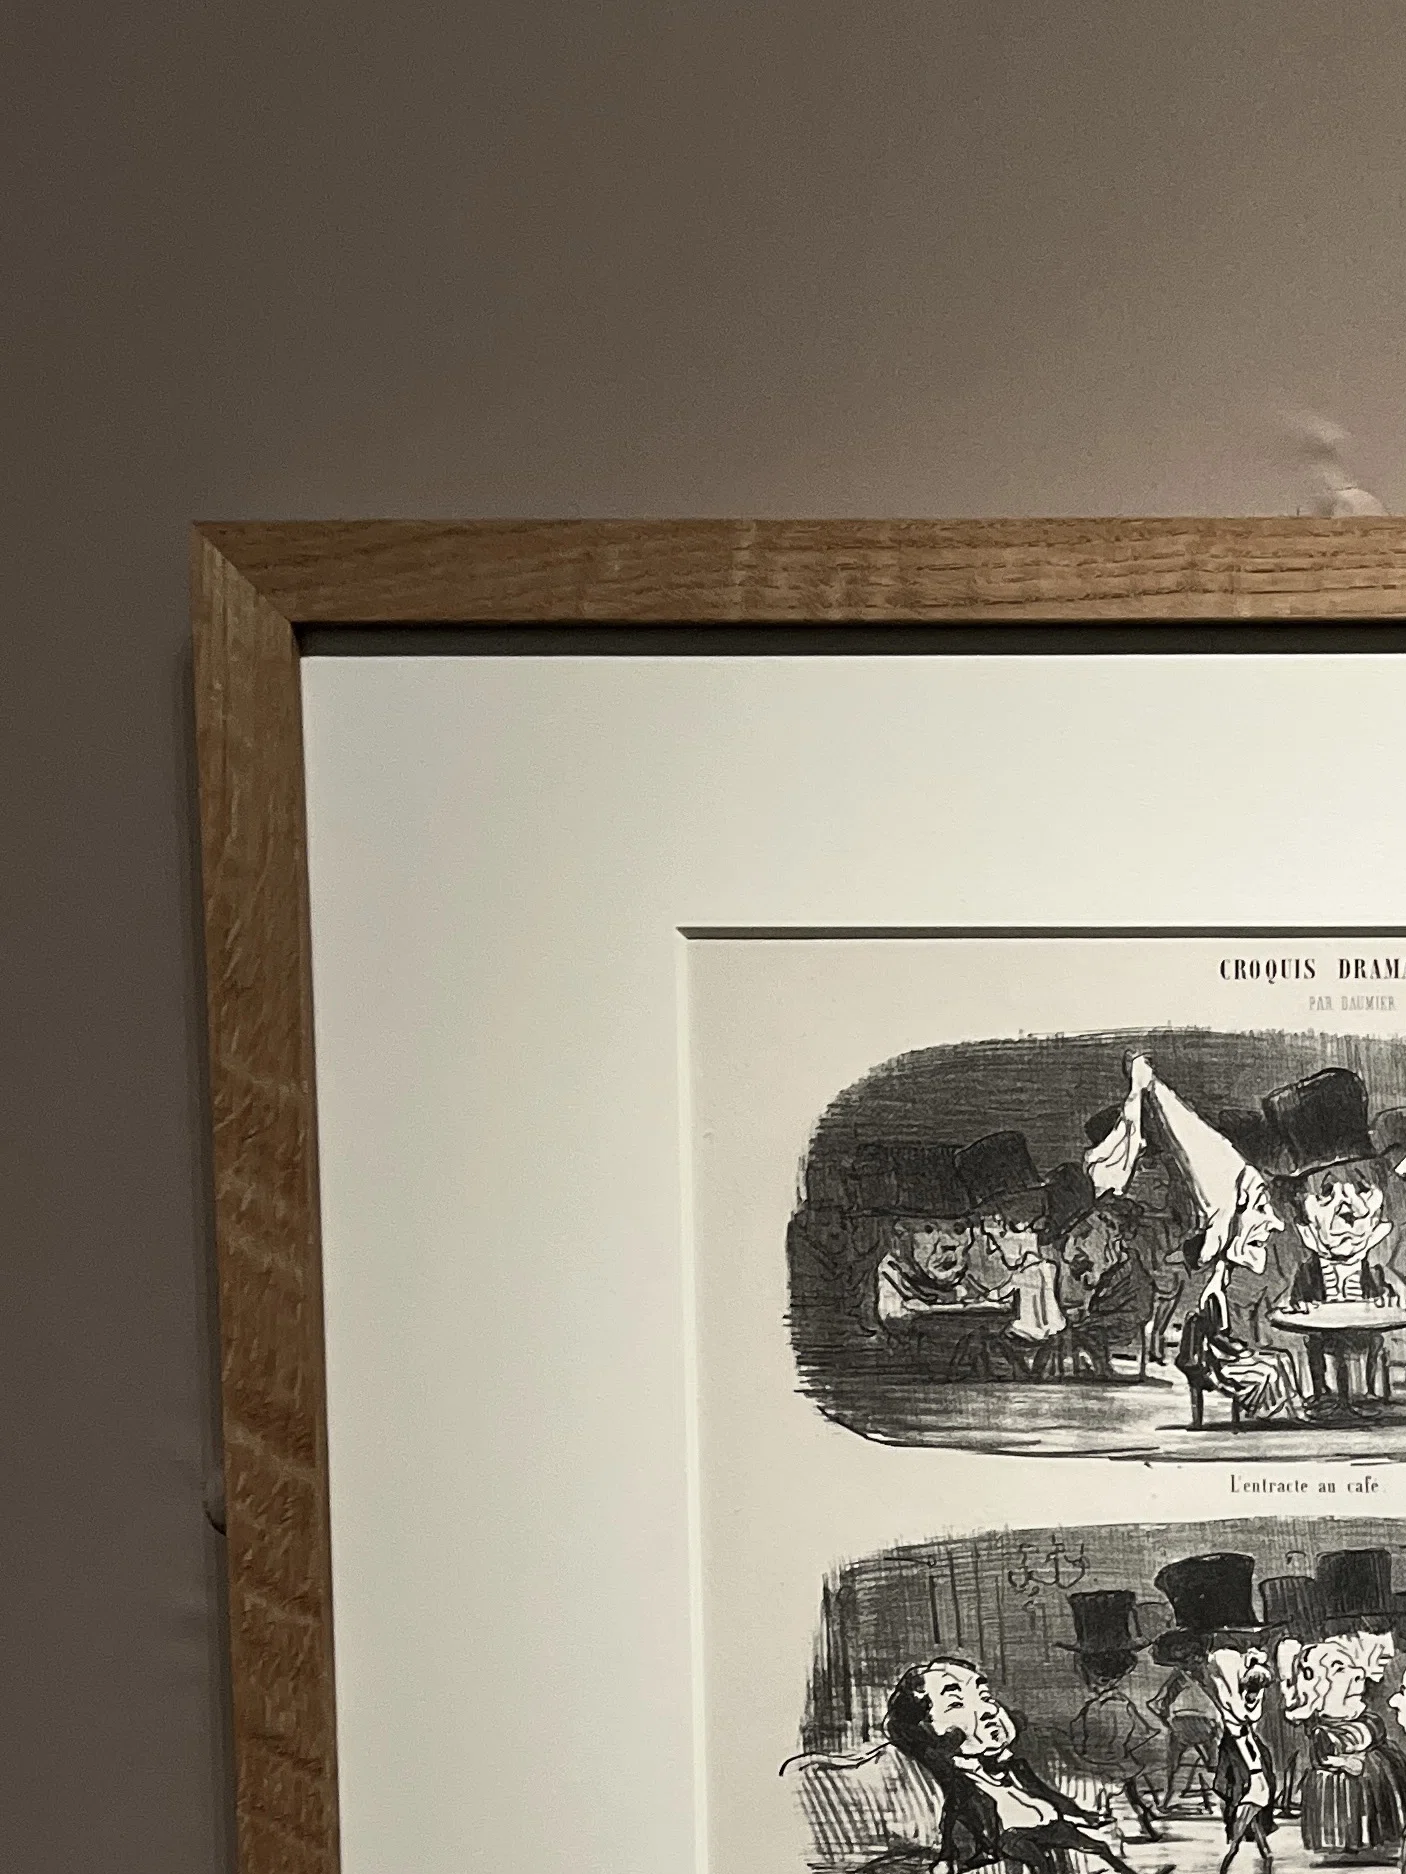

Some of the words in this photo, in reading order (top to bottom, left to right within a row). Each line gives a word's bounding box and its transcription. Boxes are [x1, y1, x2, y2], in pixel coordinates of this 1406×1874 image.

[1219, 958, 1316, 984] CROQUIS
[1309, 995, 1332, 1011] PAR
[1230, 1474, 1308, 1493] L'entracte
[1318, 1480, 1336, 1493] au
